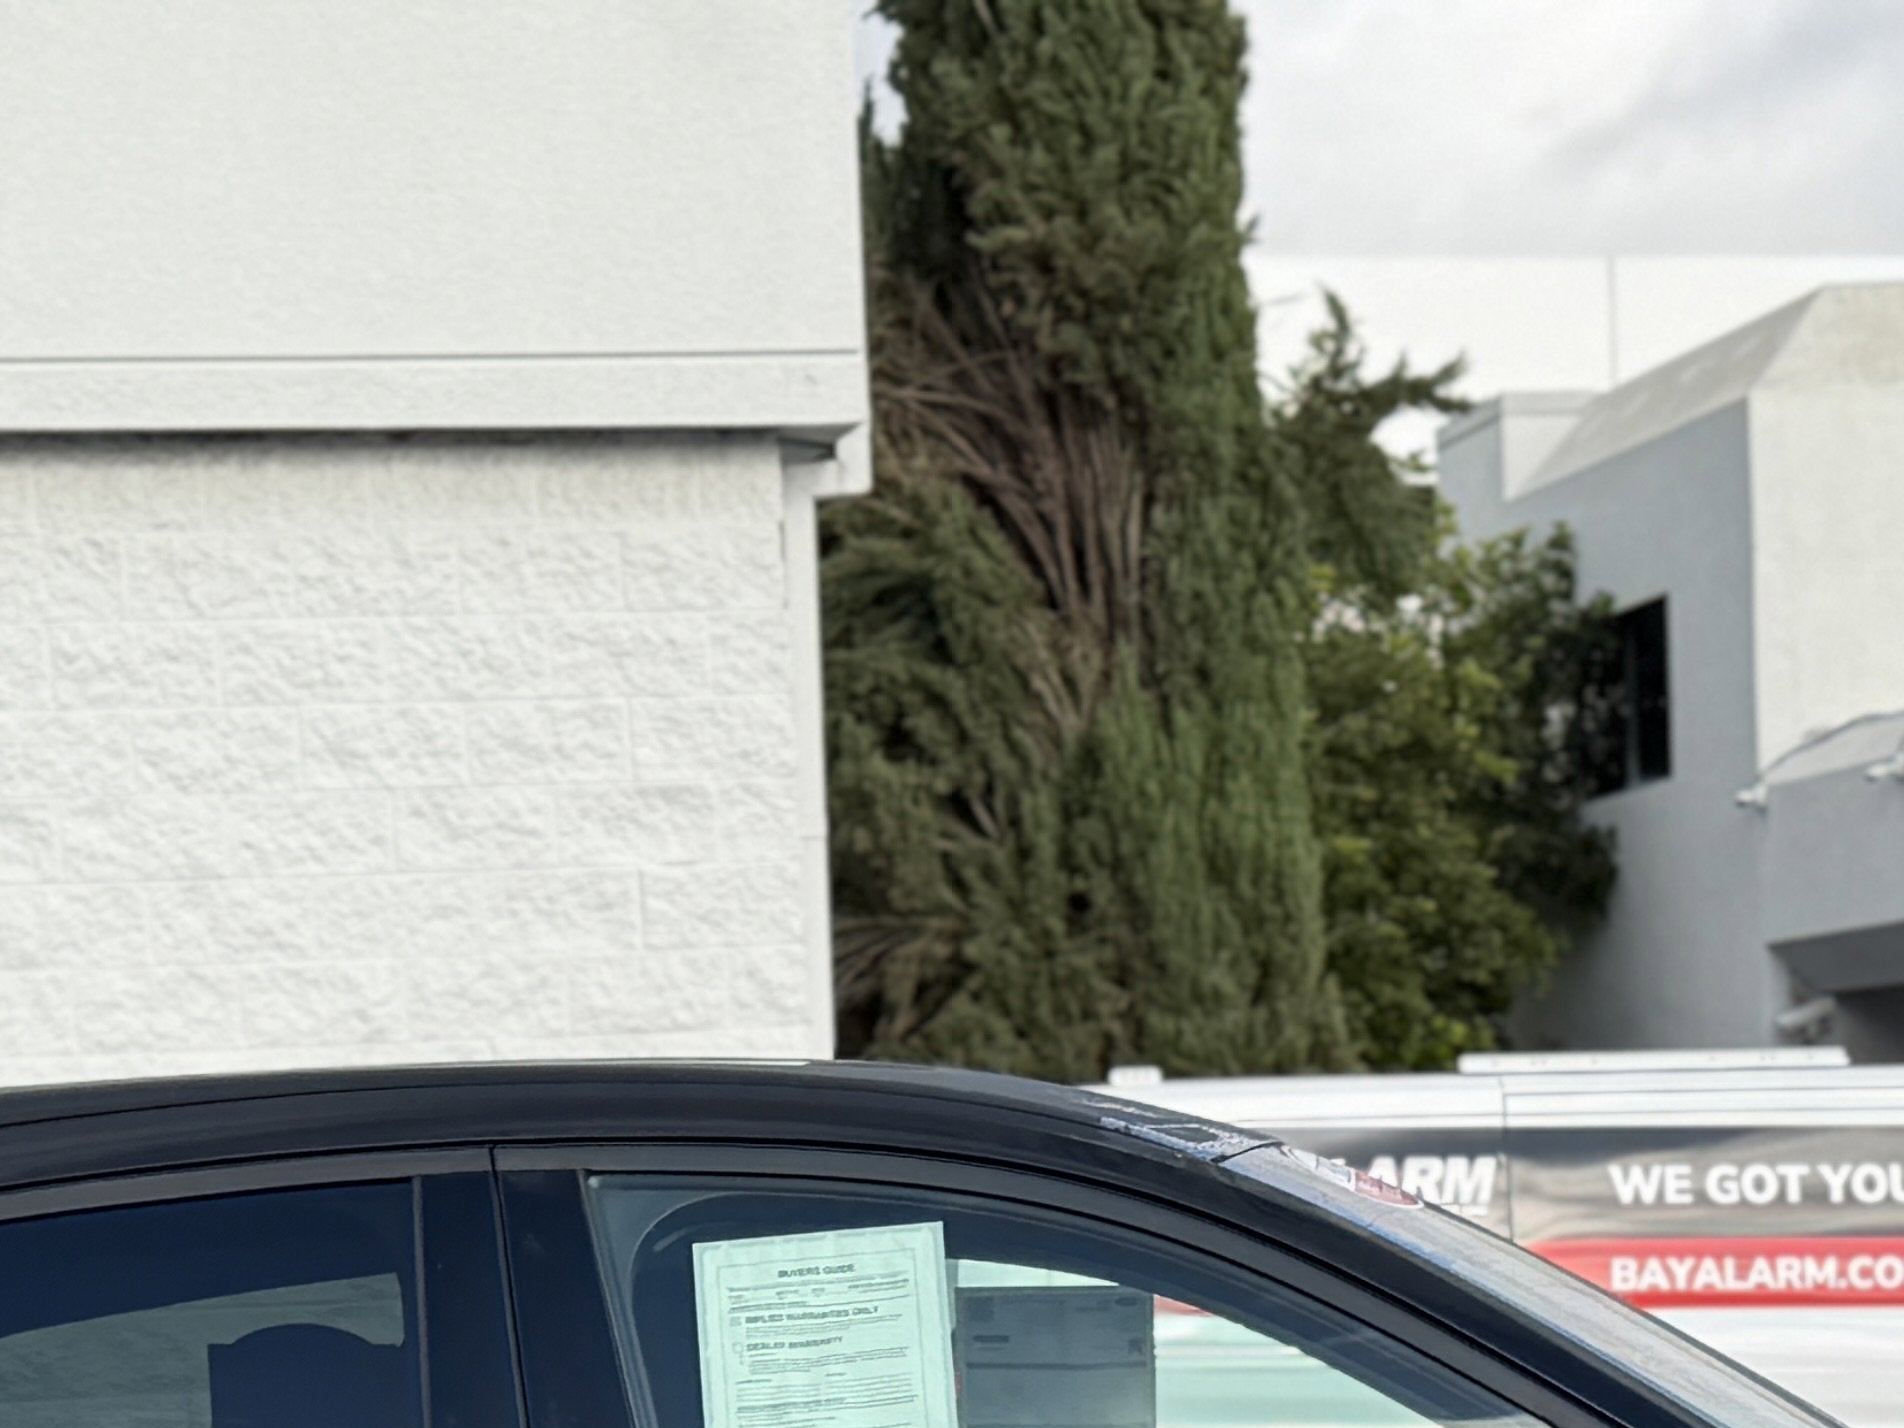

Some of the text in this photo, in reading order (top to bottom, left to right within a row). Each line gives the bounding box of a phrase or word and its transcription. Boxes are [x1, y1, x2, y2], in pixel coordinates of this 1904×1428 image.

[1330, 1155, 1496, 1204] ARM
[1608, 1164, 1693, 1204] WE
[1705, 1164, 1809, 1204] GOT
